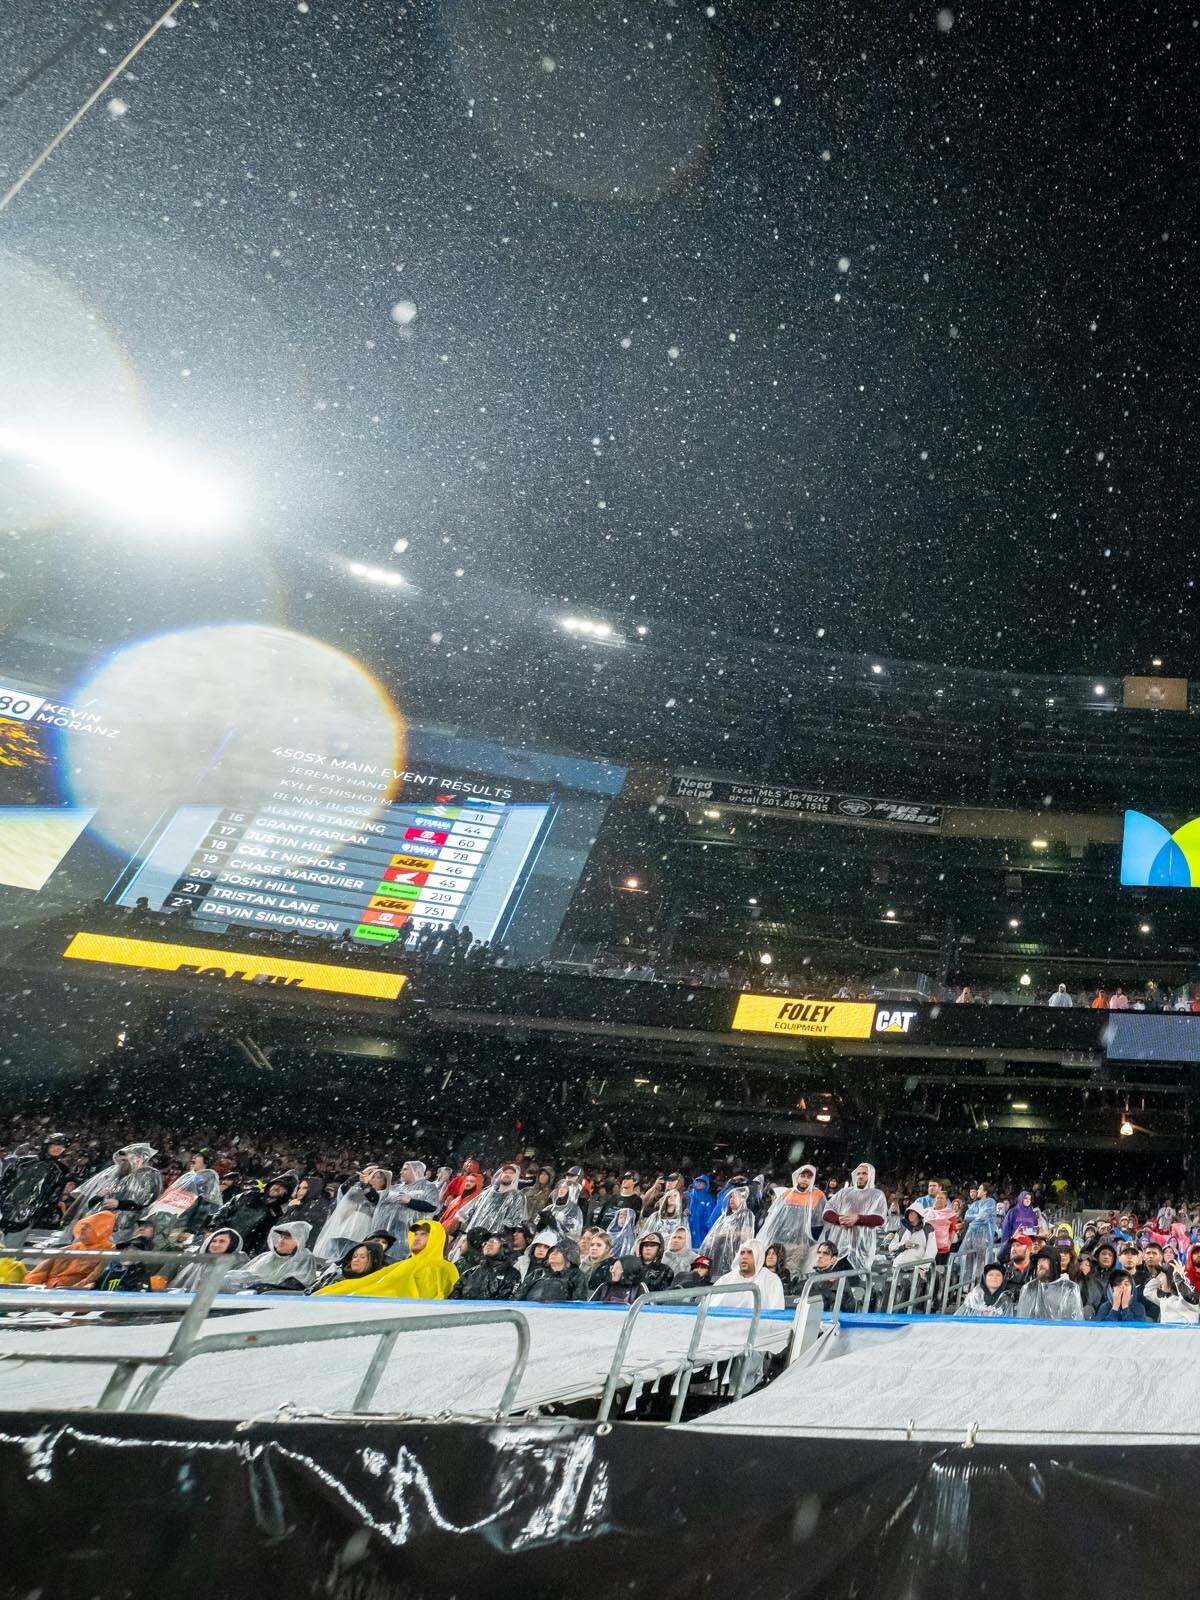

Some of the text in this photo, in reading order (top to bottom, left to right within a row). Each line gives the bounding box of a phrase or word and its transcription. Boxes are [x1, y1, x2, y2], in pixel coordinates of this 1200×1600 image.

[36, 713, 121, 738] MORANZ
[44, 703, 102, 723] KEVIN
[271, 746, 513, 799] 450SX MAIN EVENT RESULTS
[287, 766, 388, 791] JEREMY HAND
[680, 778, 713, 790] Need
[676, 787, 714, 799] Help?
[264, 805, 387, 833] JUSTIN STARLING
[874, 803, 921, 815] FANS
[886, 812, 939, 824] FIRST
[229, 812, 245, 822] 16
[255, 818, 308, 833] GRANT
[308, 828, 369, 845] HARLAN
[452, 852, 469, 861] 78
[463, 825, 481, 836] 44
[220, 825, 463, 875] 17 JUSTIN HILL KTM 46
[458, 838, 476, 849] 60
[211, 839, 457, 888] 18 COLT NICHOLS 45
[202, 853, 219, 864] 19
[229, 859, 281, 876] CHASE
[283, 868, 365, 889] MARQUIER
[430, 892, 452, 902] 219
[182, 882, 321, 913] 21 TRISTAN LANE
[189, 868, 446, 917] 20 JOSH HILL KTM 751
[202, 902, 254, 919] DEVIN
[254, 911, 340, 933] SIMONSON
[777, 1003, 835, 1023] FOLEY
[875, 1010, 916, 1032] CAT
[774, 1021, 830, 1034] EQUIPMENT
